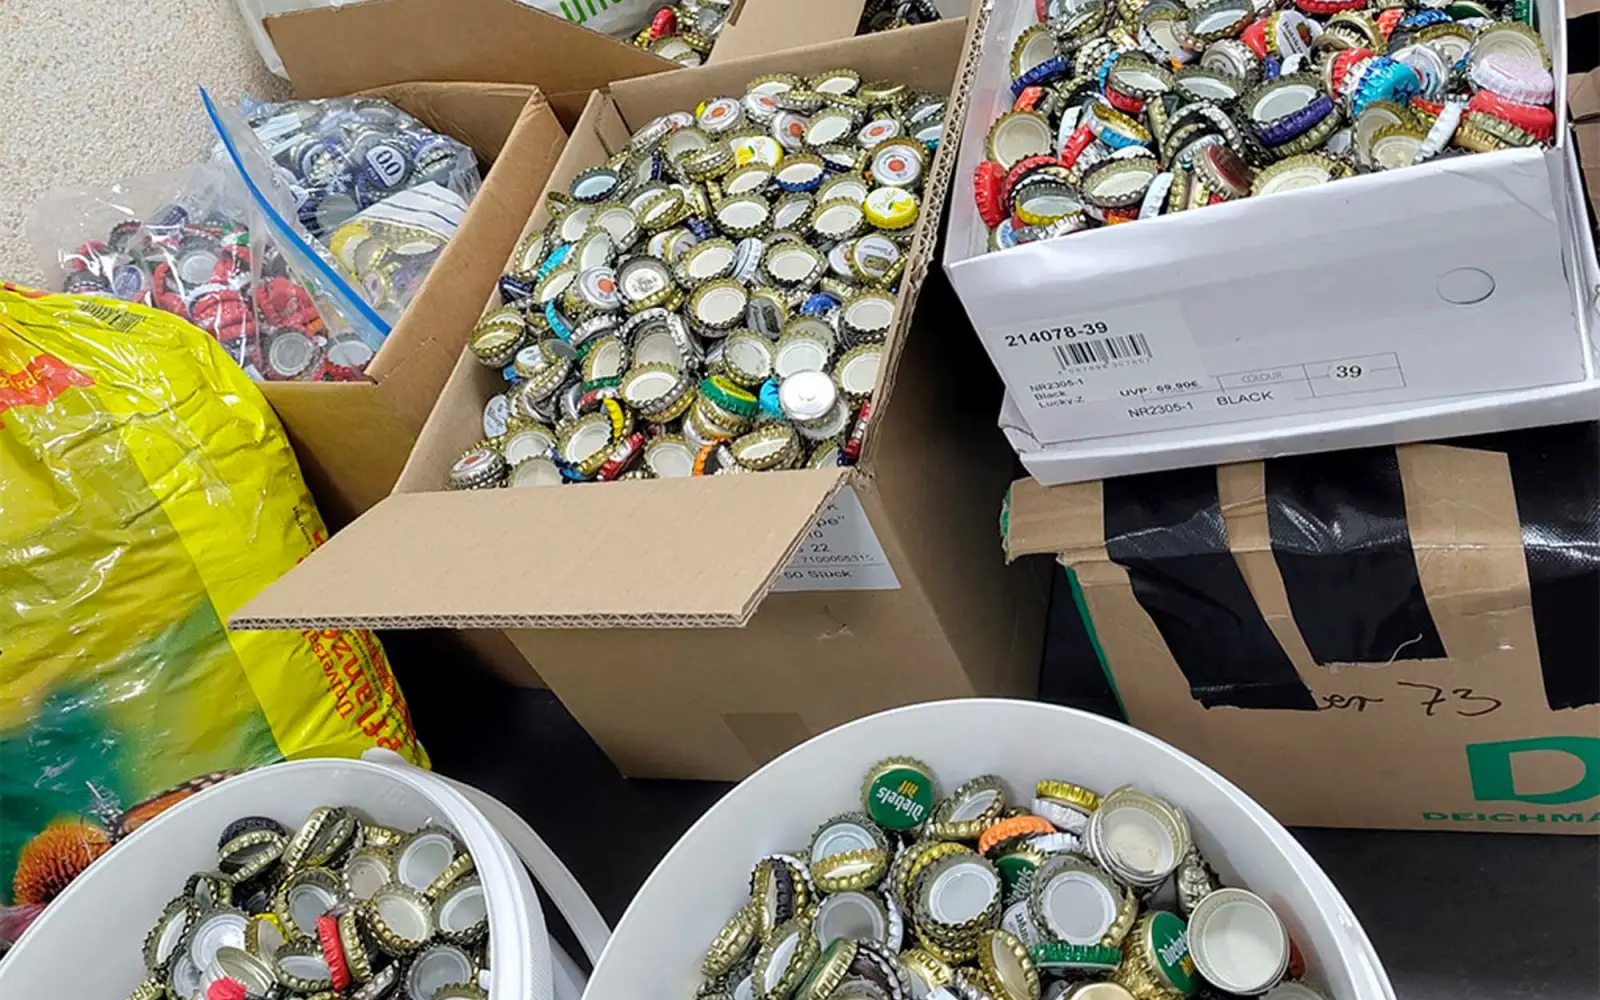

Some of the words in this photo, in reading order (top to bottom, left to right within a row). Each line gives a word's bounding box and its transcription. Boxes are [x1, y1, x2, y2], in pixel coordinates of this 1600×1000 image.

[1004, 321, 1109, 348] 214078-39
[1336, 365, 1363, 379] 39
[1033, 390, 1067, 401] Black
[1216, 390, 1275, 407] BLACK
[1127, 401, 1194, 419] NR2305-1
[1396, 681, 1502, 717] 73
[1465, 736, 1600, 806] D
[876, 787, 925, 822] Diebels
